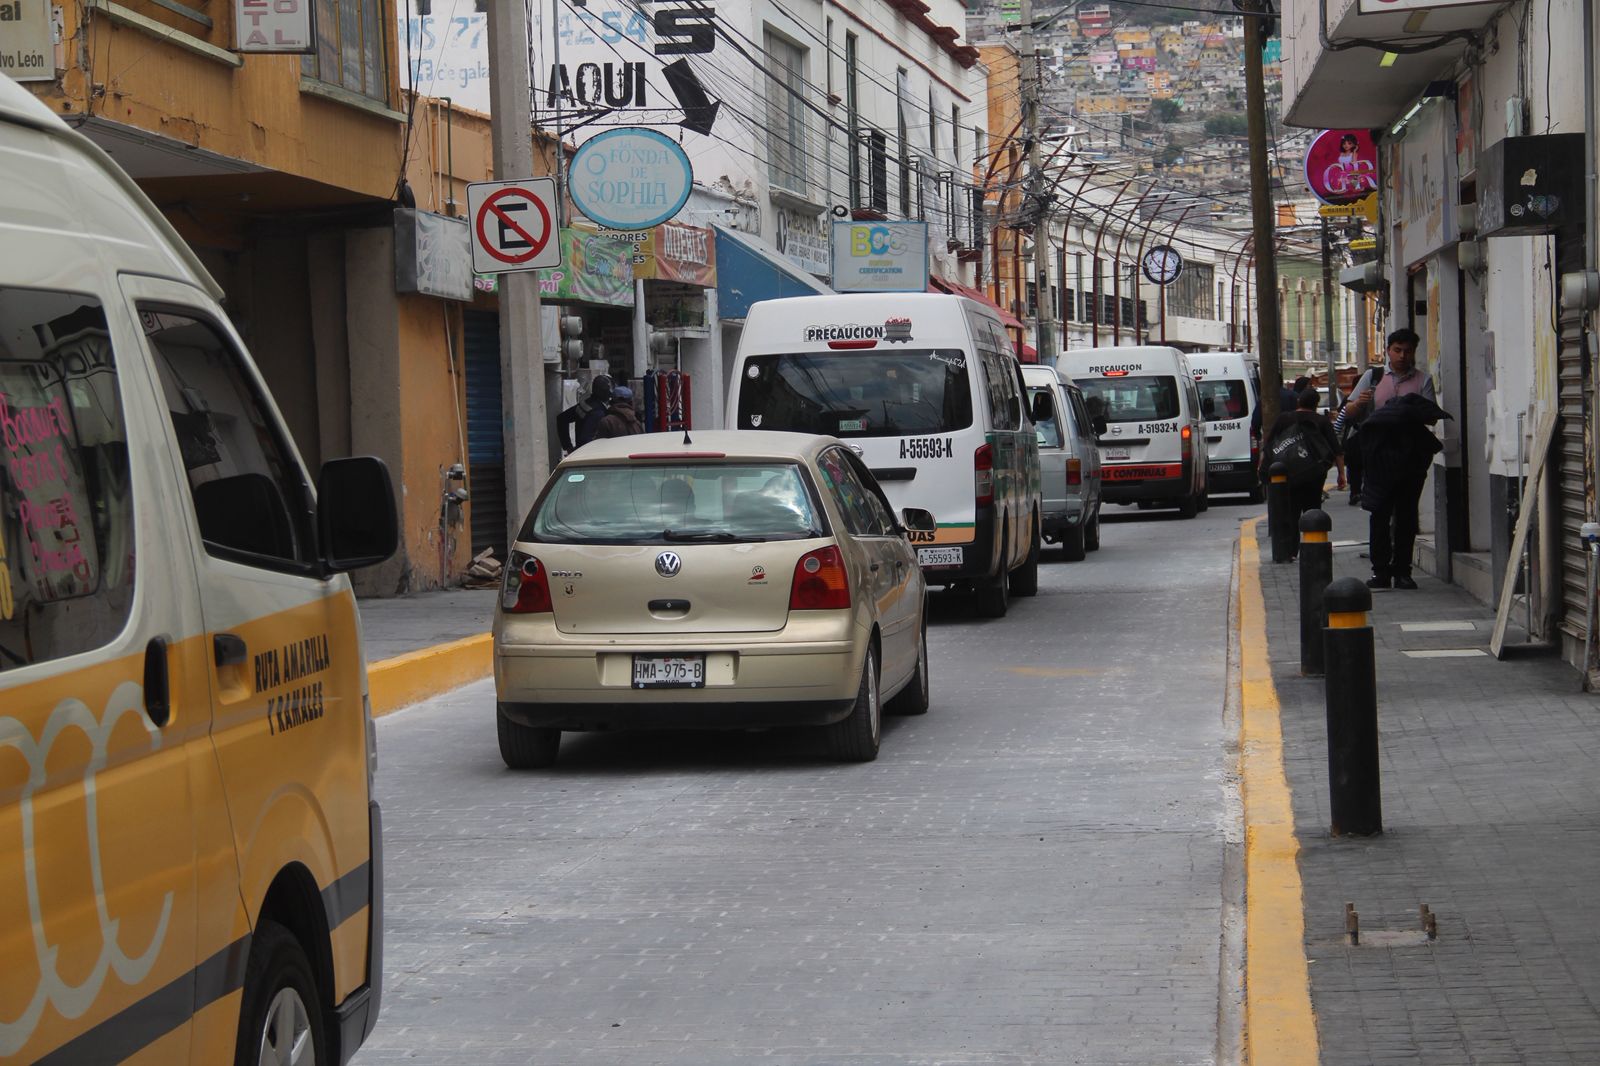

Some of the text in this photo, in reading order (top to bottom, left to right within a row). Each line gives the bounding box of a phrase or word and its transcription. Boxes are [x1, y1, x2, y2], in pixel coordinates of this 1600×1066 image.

[17, 50, 44, 68] León
[546, 61, 648, 110] AQUI
[610, 149, 670, 165] FONDA
[630, 166, 648, 178] DE
[588, 180, 668, 205] SOPHIA
[807, 326, 884, 341] PRECAUCION
[1088, 363, 1142, 374] PRECAUCION
[1138, 422, 1179, 435] A-51932-K
[899, 437, 953, 460] A-55593-K
[919, 552, 962, 565] A-55593-K
[254, 633, 330, 694] RUTA AMARILLA
[635, 662, 702, 679] HMA-975-B
[276, 681, 324, 733] RAMALES
